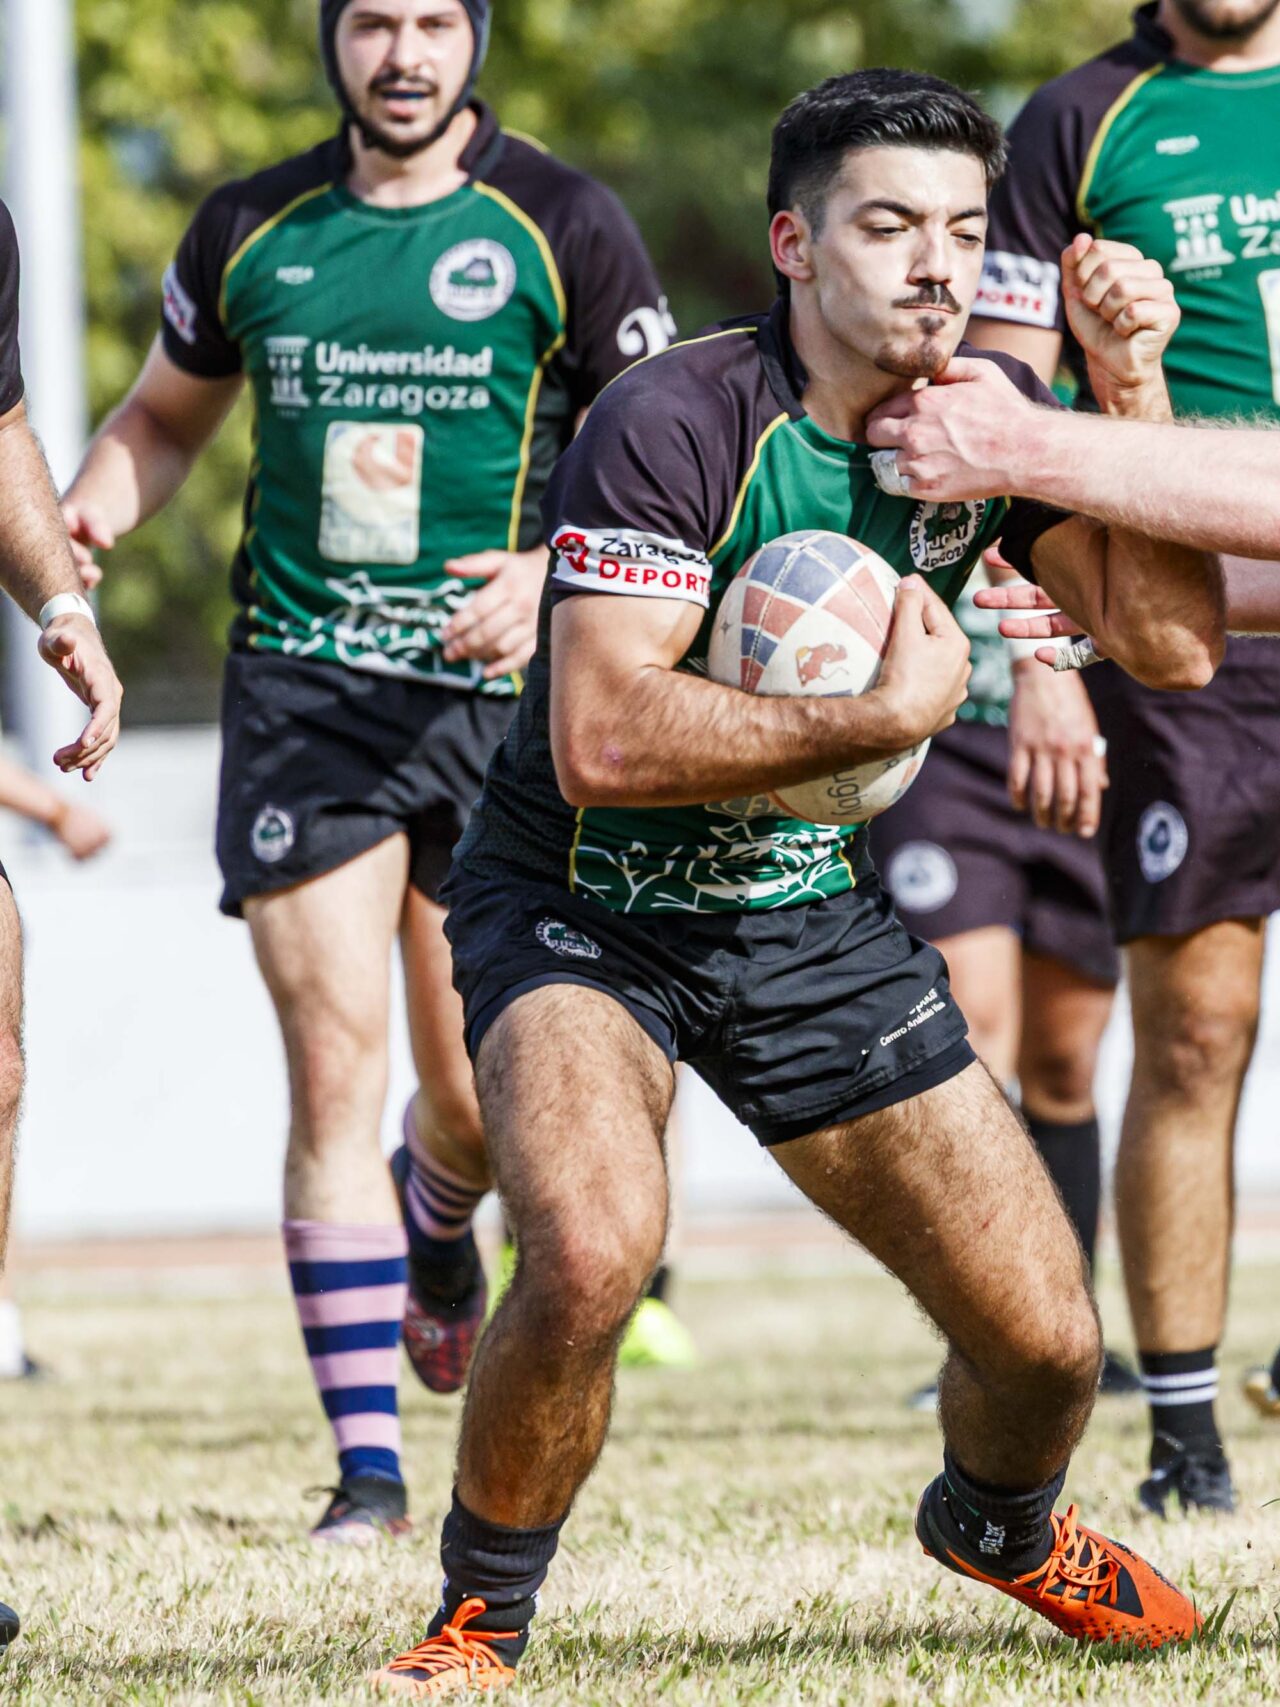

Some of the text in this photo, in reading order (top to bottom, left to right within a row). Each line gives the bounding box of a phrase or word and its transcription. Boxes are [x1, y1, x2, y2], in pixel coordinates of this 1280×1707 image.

[315, 341, 493, 377] Universidad
[316, 375, 491, 416] Zaragoza
[827, 767, 868, 816] ugby
